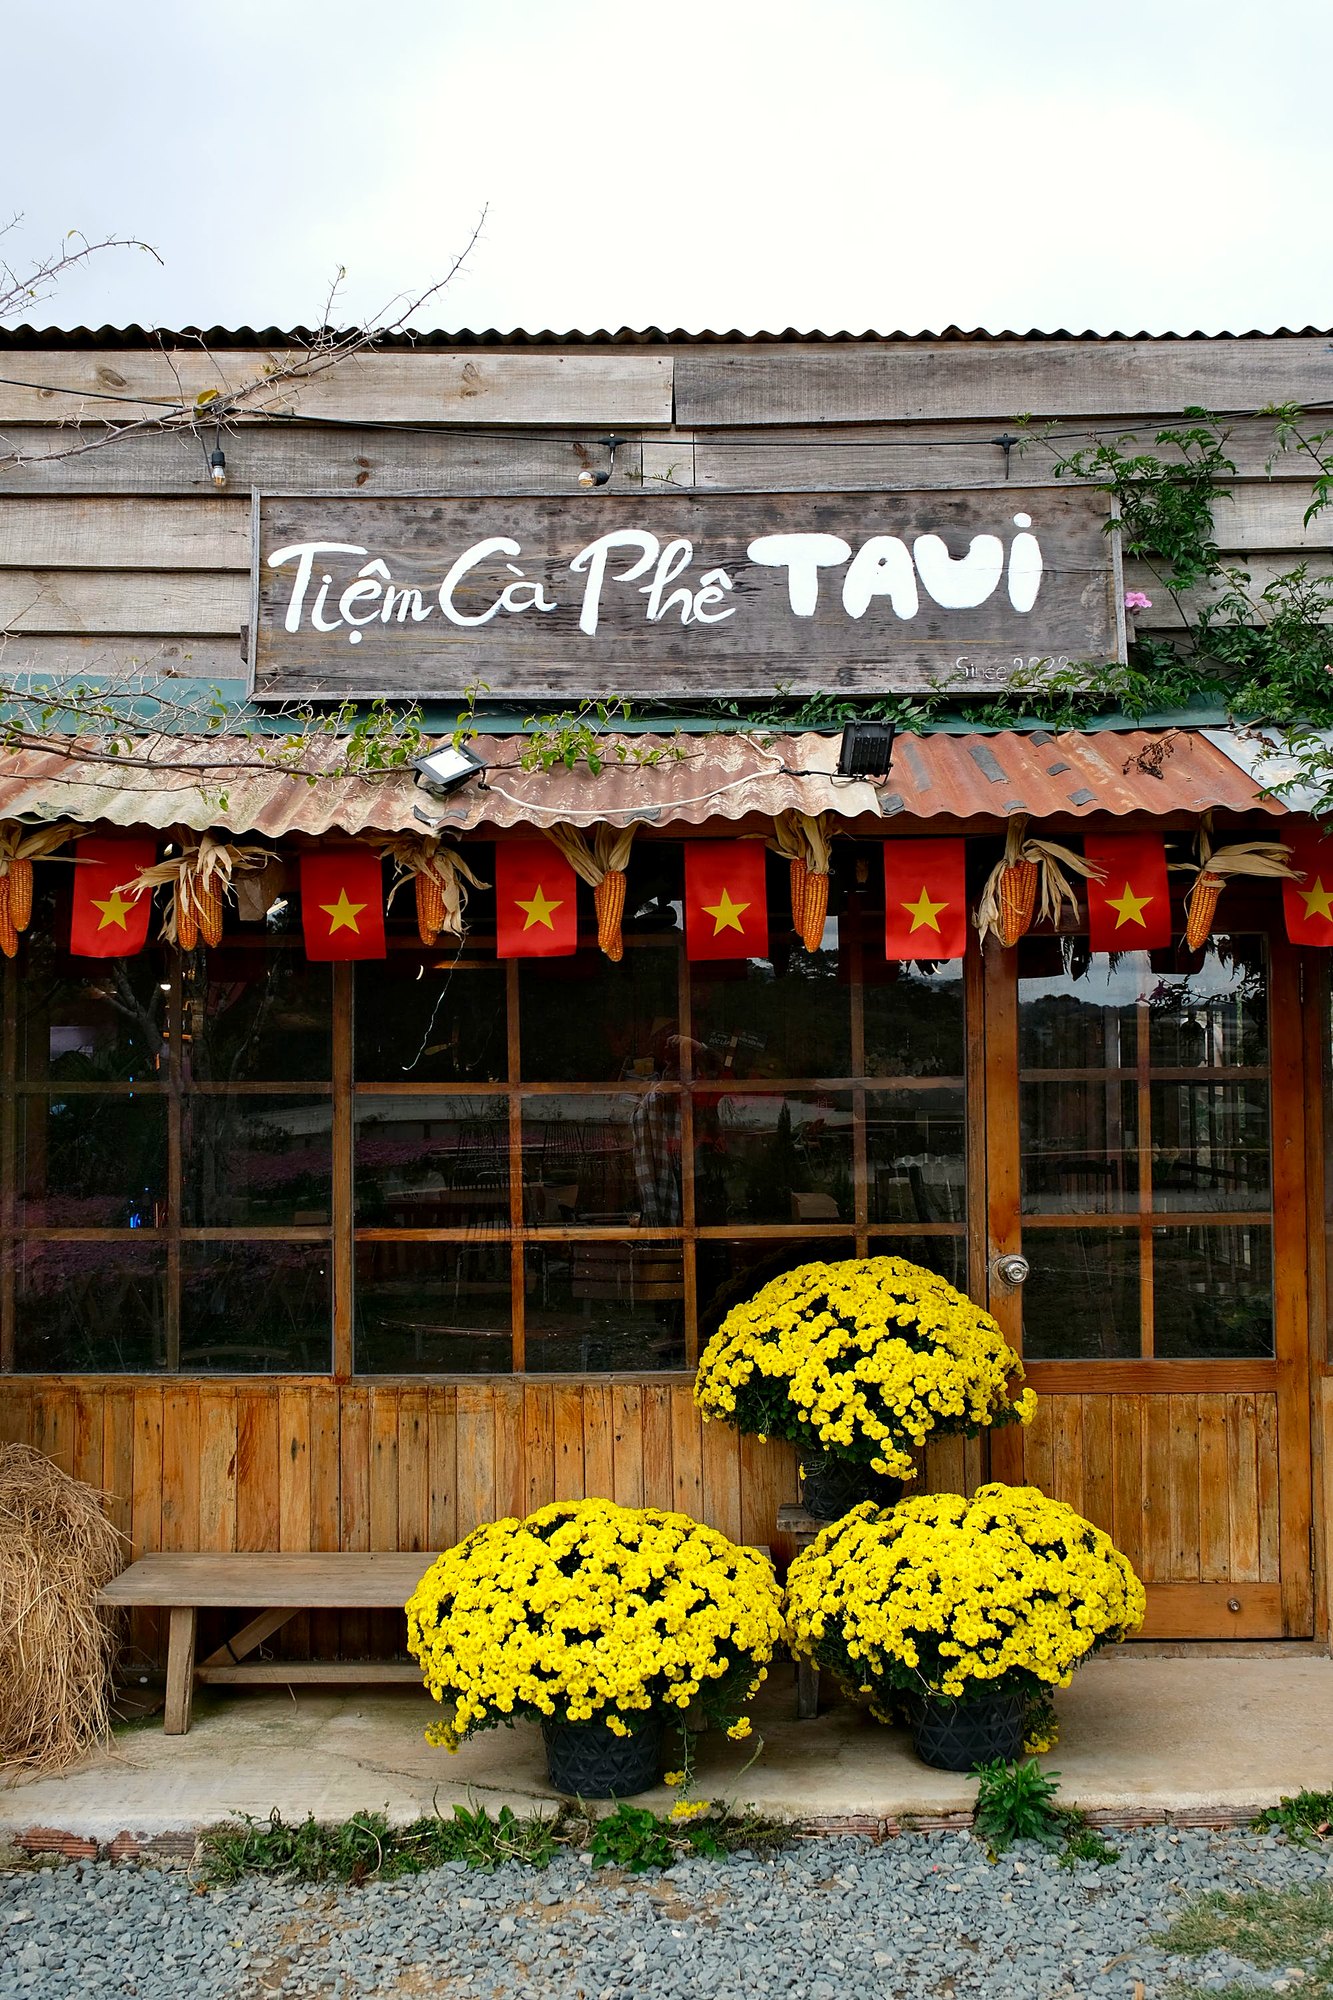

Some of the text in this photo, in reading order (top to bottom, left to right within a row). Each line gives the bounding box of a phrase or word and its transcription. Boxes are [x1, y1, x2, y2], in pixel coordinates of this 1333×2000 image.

[267, 541, 434, 644] Tiệm
[438, 536, 558, 627] Cà
[569, 529, 737, 636] Phê
[956, 656, 1008, 680] Since
